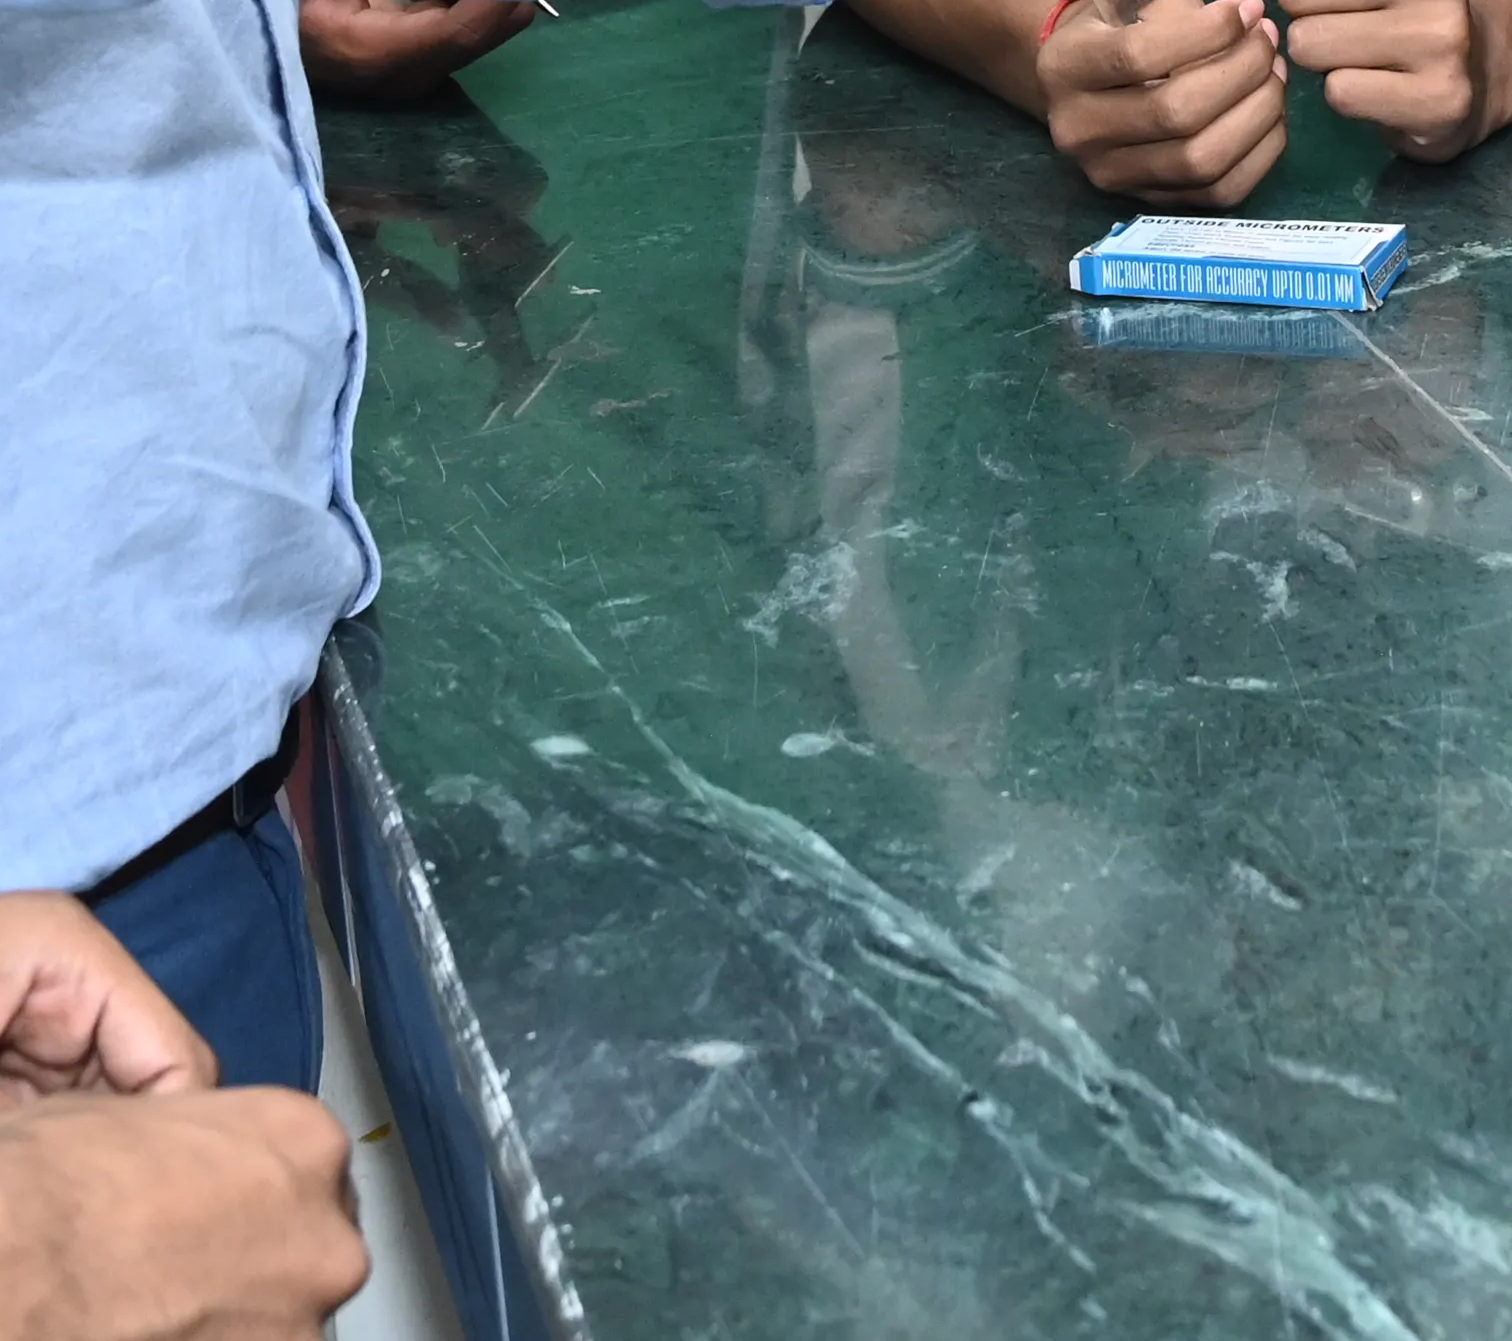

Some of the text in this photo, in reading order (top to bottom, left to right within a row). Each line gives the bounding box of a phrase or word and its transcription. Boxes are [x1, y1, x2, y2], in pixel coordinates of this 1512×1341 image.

[1141, 216, 1386, 235] OUTSIDE MICROMETERS
[1101, 259, 1355, 305] MICROMETER FOR ACCURACY UPTO 0.01 MM
